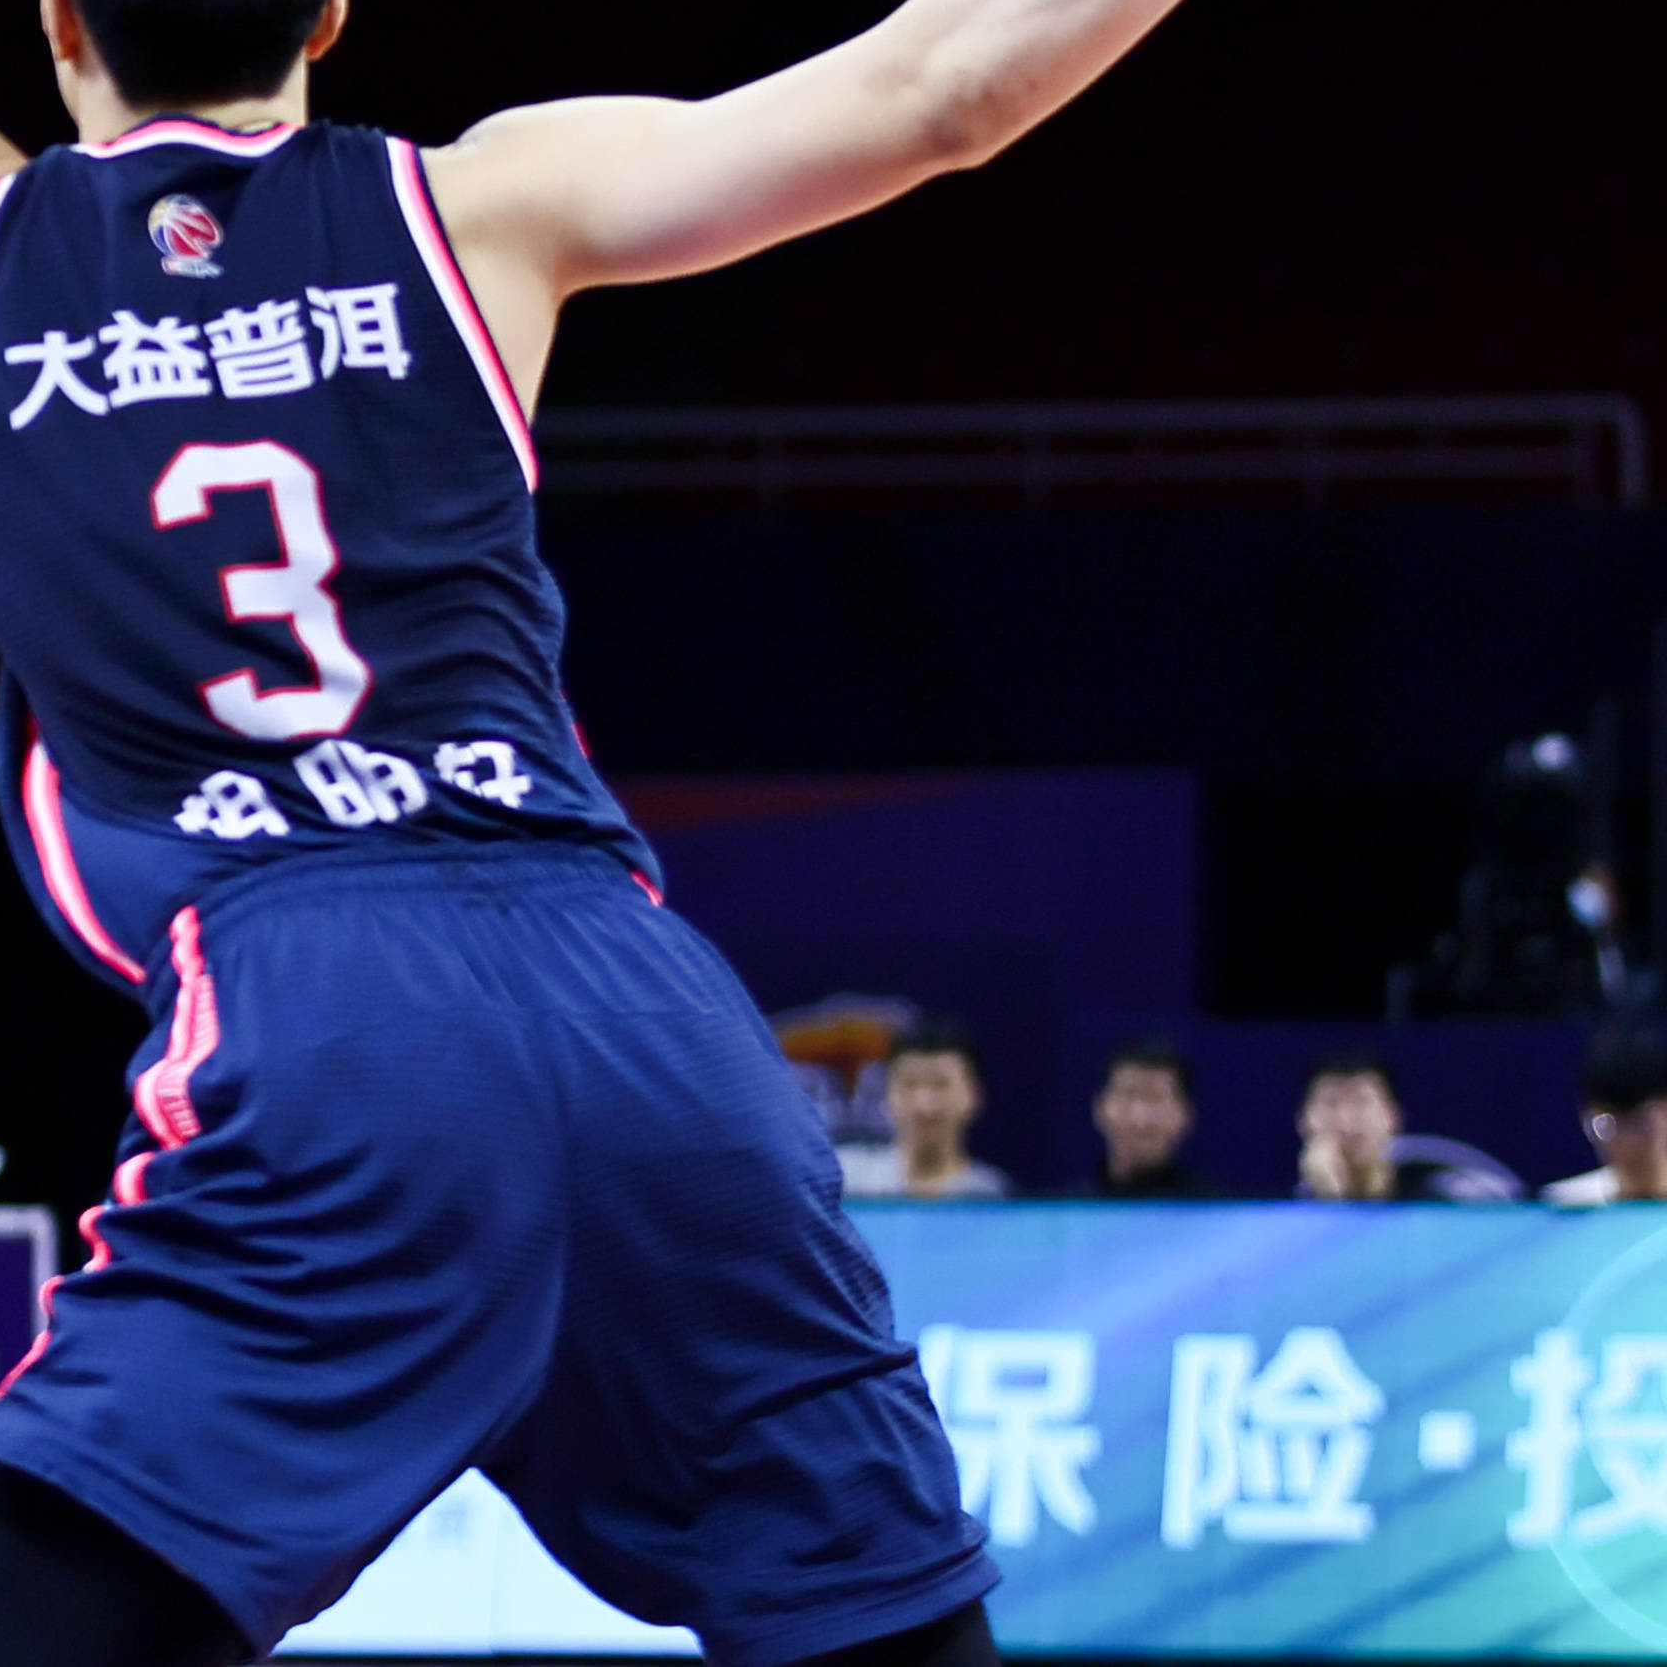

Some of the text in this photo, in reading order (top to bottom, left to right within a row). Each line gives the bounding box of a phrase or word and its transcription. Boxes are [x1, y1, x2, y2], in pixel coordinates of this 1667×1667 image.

[3, 282, 412, 430] 大益普洱
[149, 439, 371, 740] 3
